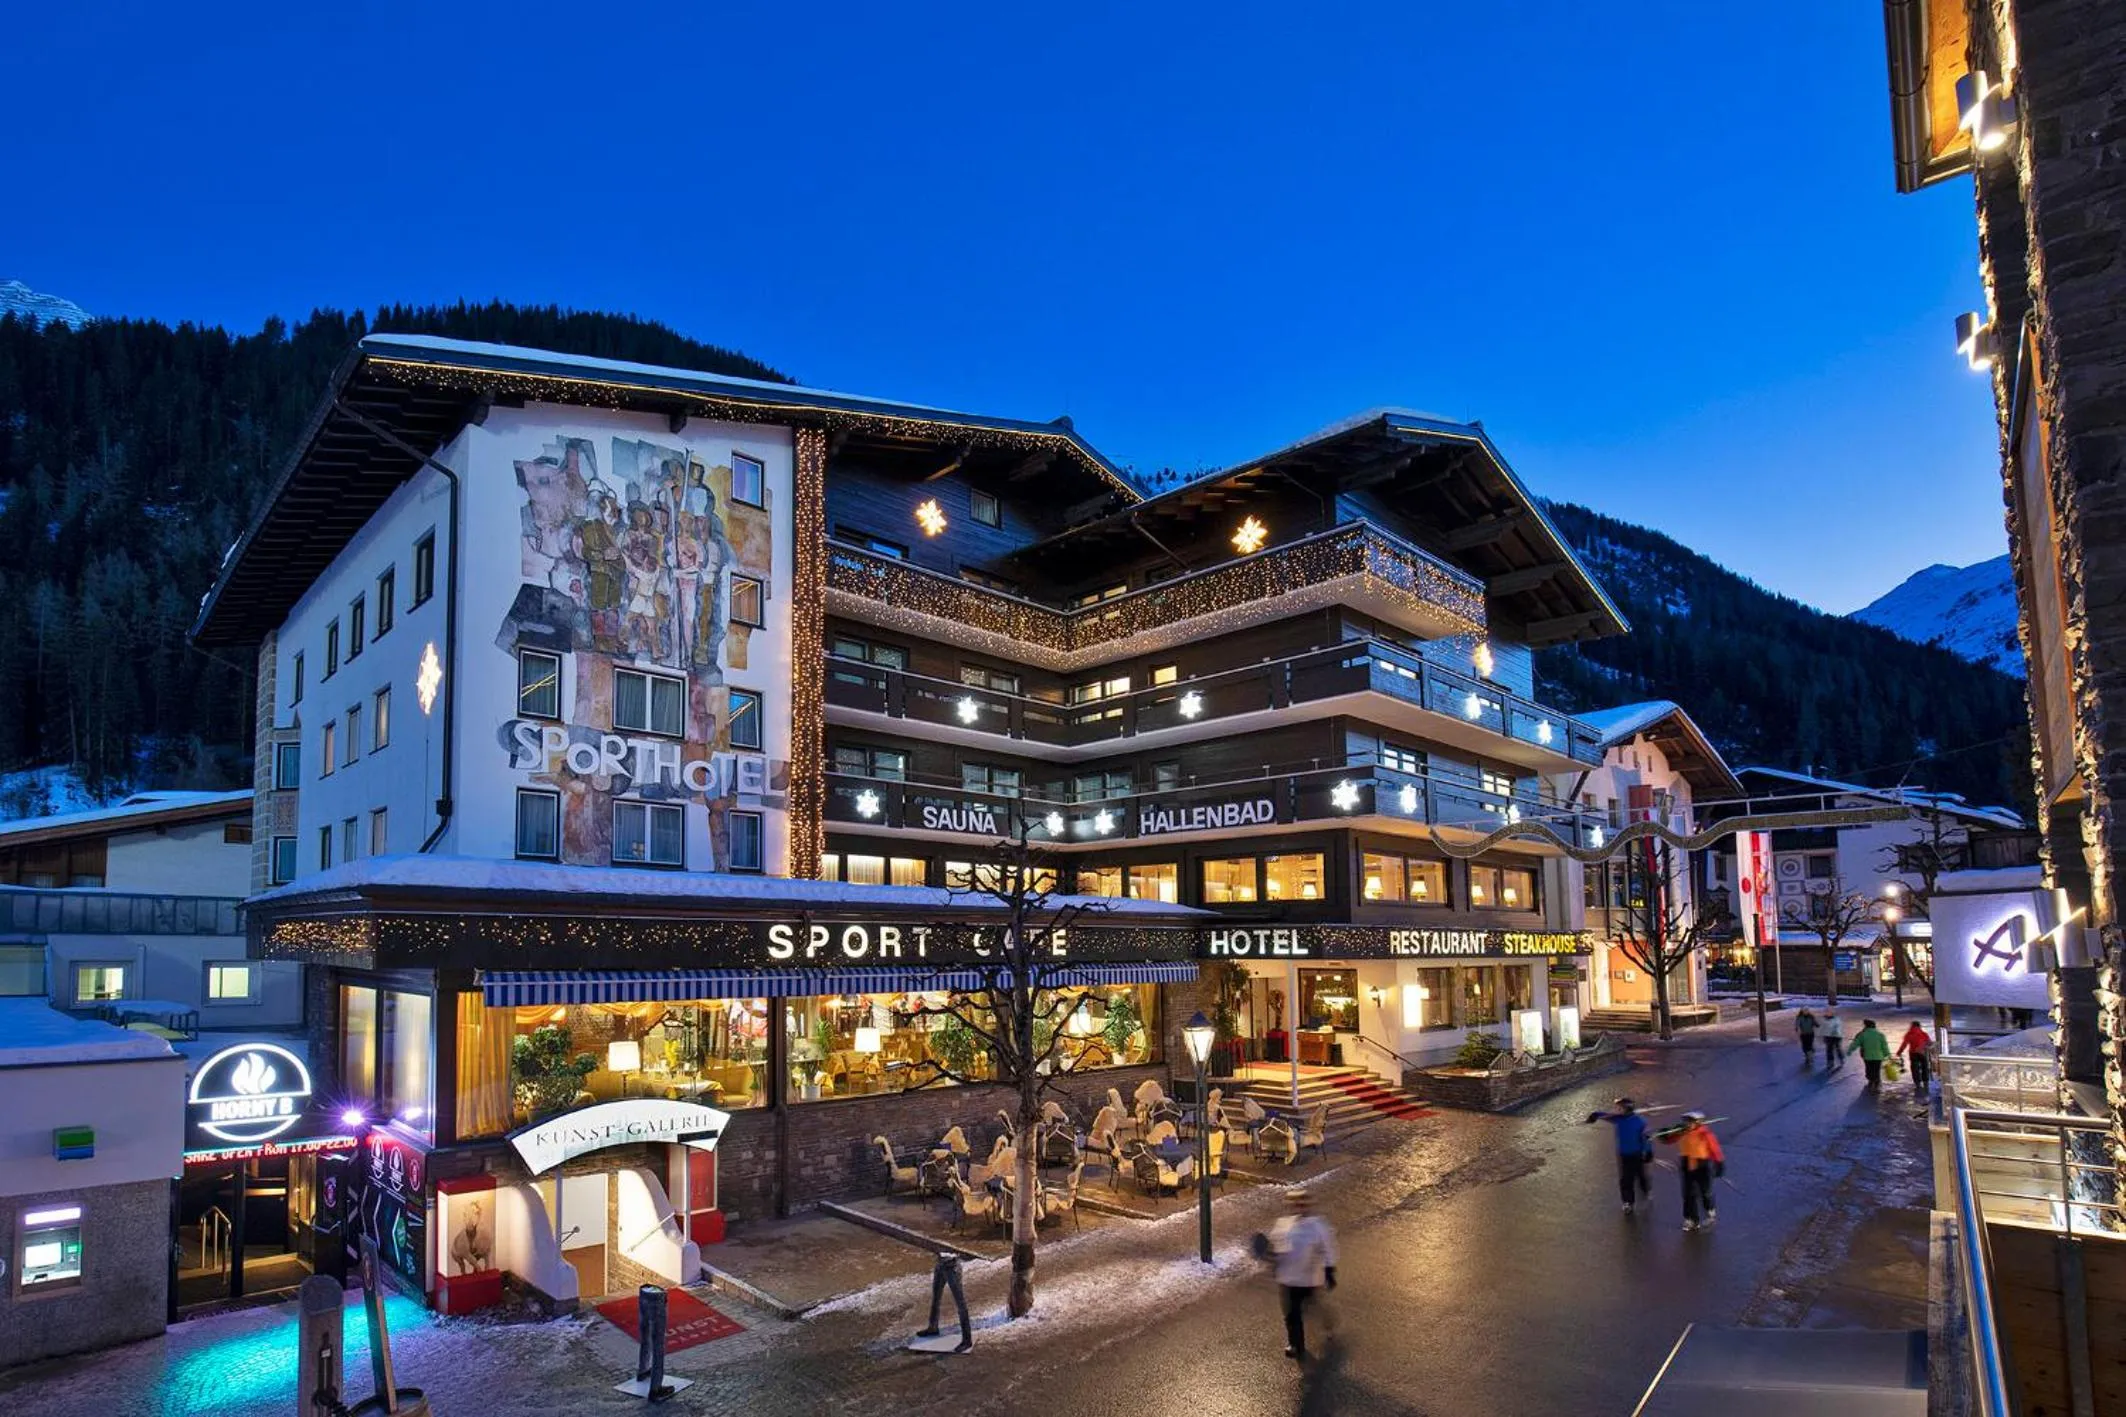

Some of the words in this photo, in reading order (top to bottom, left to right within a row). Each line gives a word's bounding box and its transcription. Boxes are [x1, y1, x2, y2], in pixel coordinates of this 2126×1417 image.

[922, 805, 998, 834] SAUNA
[1139, 799, 1275, 834] HALLENBAD
[767, 923, 932, 959] SPORT
[1210, 928, 1309, 956] HOTEL
[1388, 929, 1489, 956] RESTAURANT
[1503, 932, 1577, 955] STEAKHOUSE
[211, 1097, 277, 1121] HORNY
[279, 1095, 294, 1115] B
[664, 1317, 718, 1337] UNST
